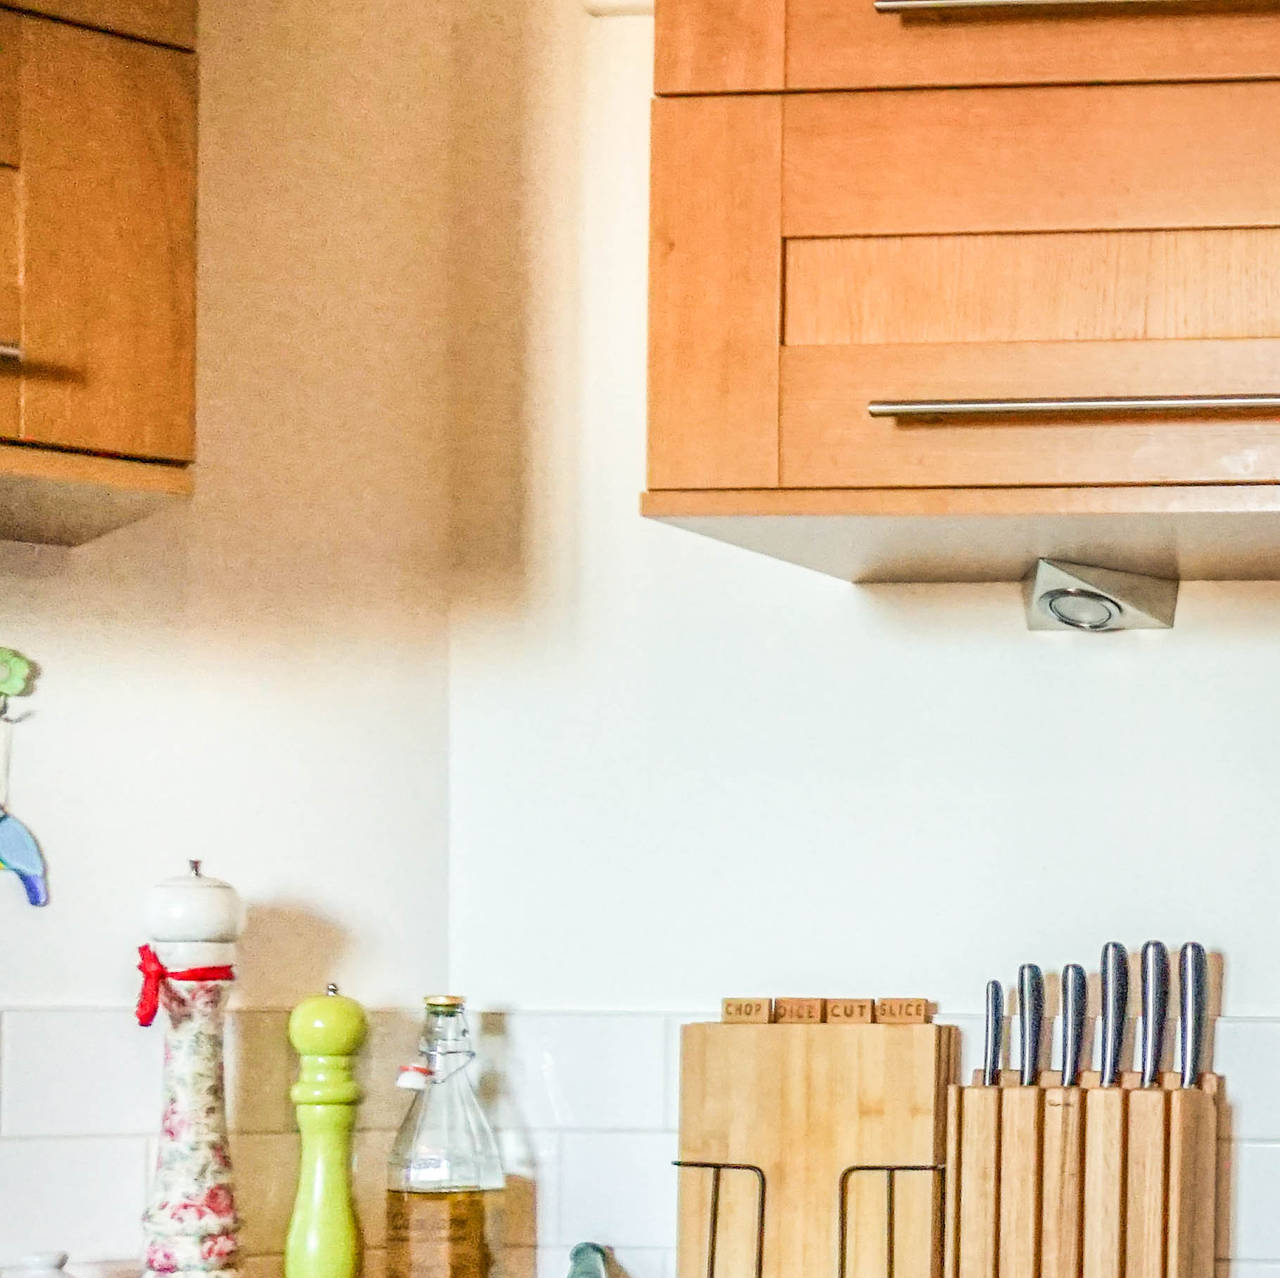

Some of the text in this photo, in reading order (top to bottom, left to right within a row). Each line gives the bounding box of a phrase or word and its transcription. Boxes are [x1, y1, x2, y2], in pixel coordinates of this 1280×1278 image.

[725, 1003, 762, 1016] CHOP
[777, 1005, 815, 1018] DICE
[831, 1004, 867, 1017] CUT
[879, 1003, 923, 1016] SLICE
